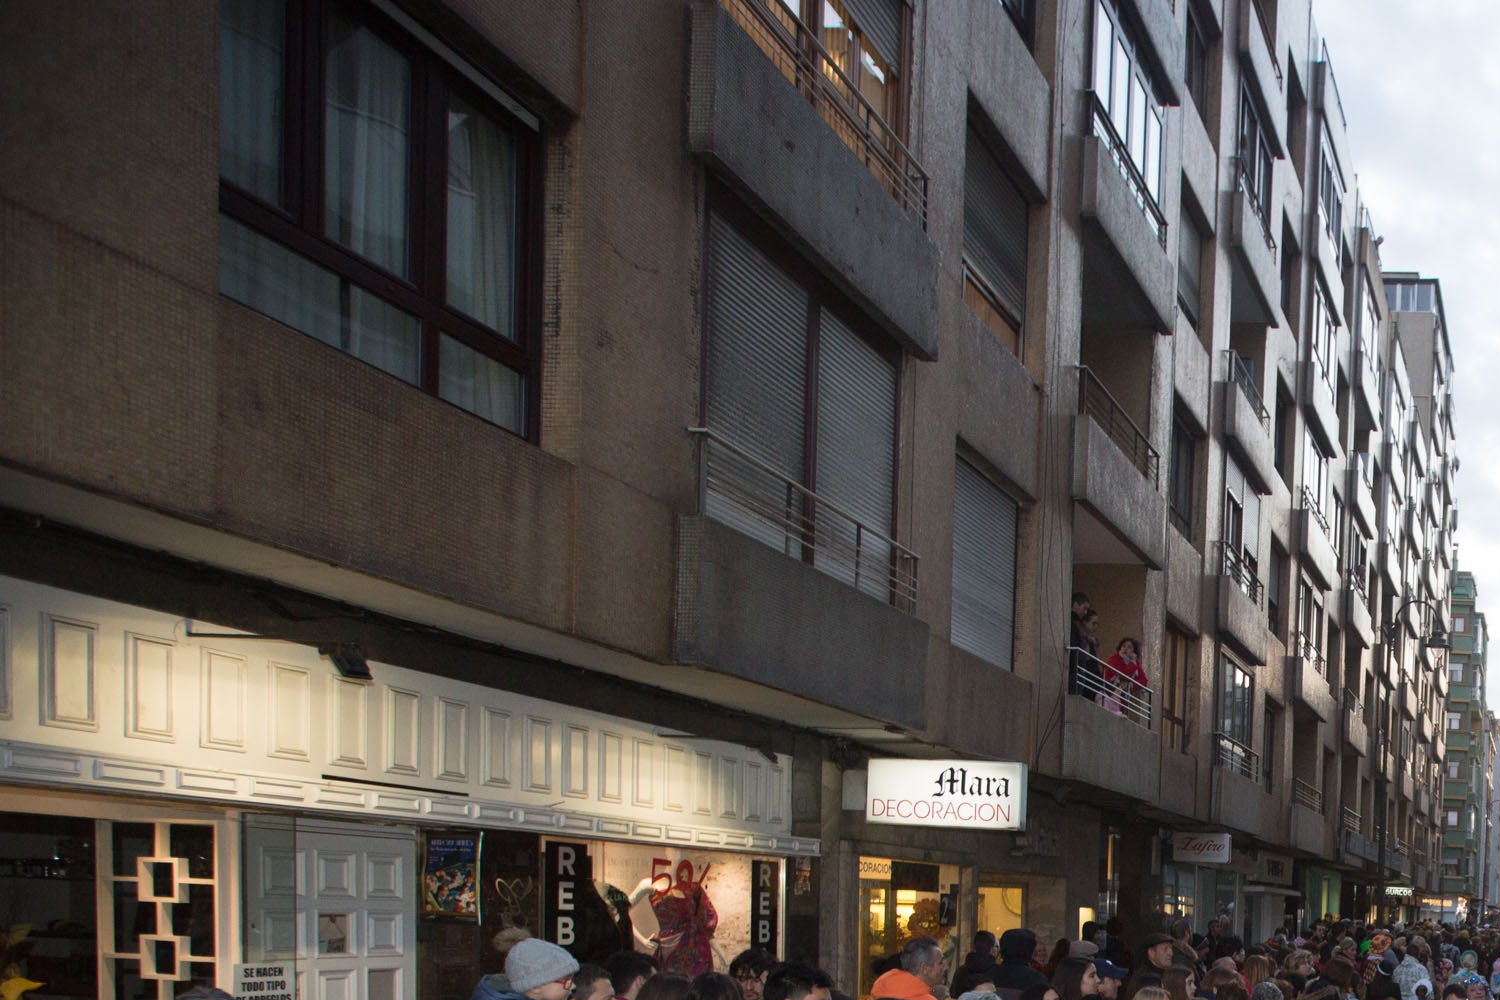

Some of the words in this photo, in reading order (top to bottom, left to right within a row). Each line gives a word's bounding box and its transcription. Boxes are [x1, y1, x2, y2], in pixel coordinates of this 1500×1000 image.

[931, 767, 1010, 798] Mara
[871, 798, 1011, 823] DECORACION
[243, 967, 255, 978] SE
[256, 966, 285, 977] HACEN
[241, 981, 265, 992] TODO
[266, 980, 287, 991] TIPO
